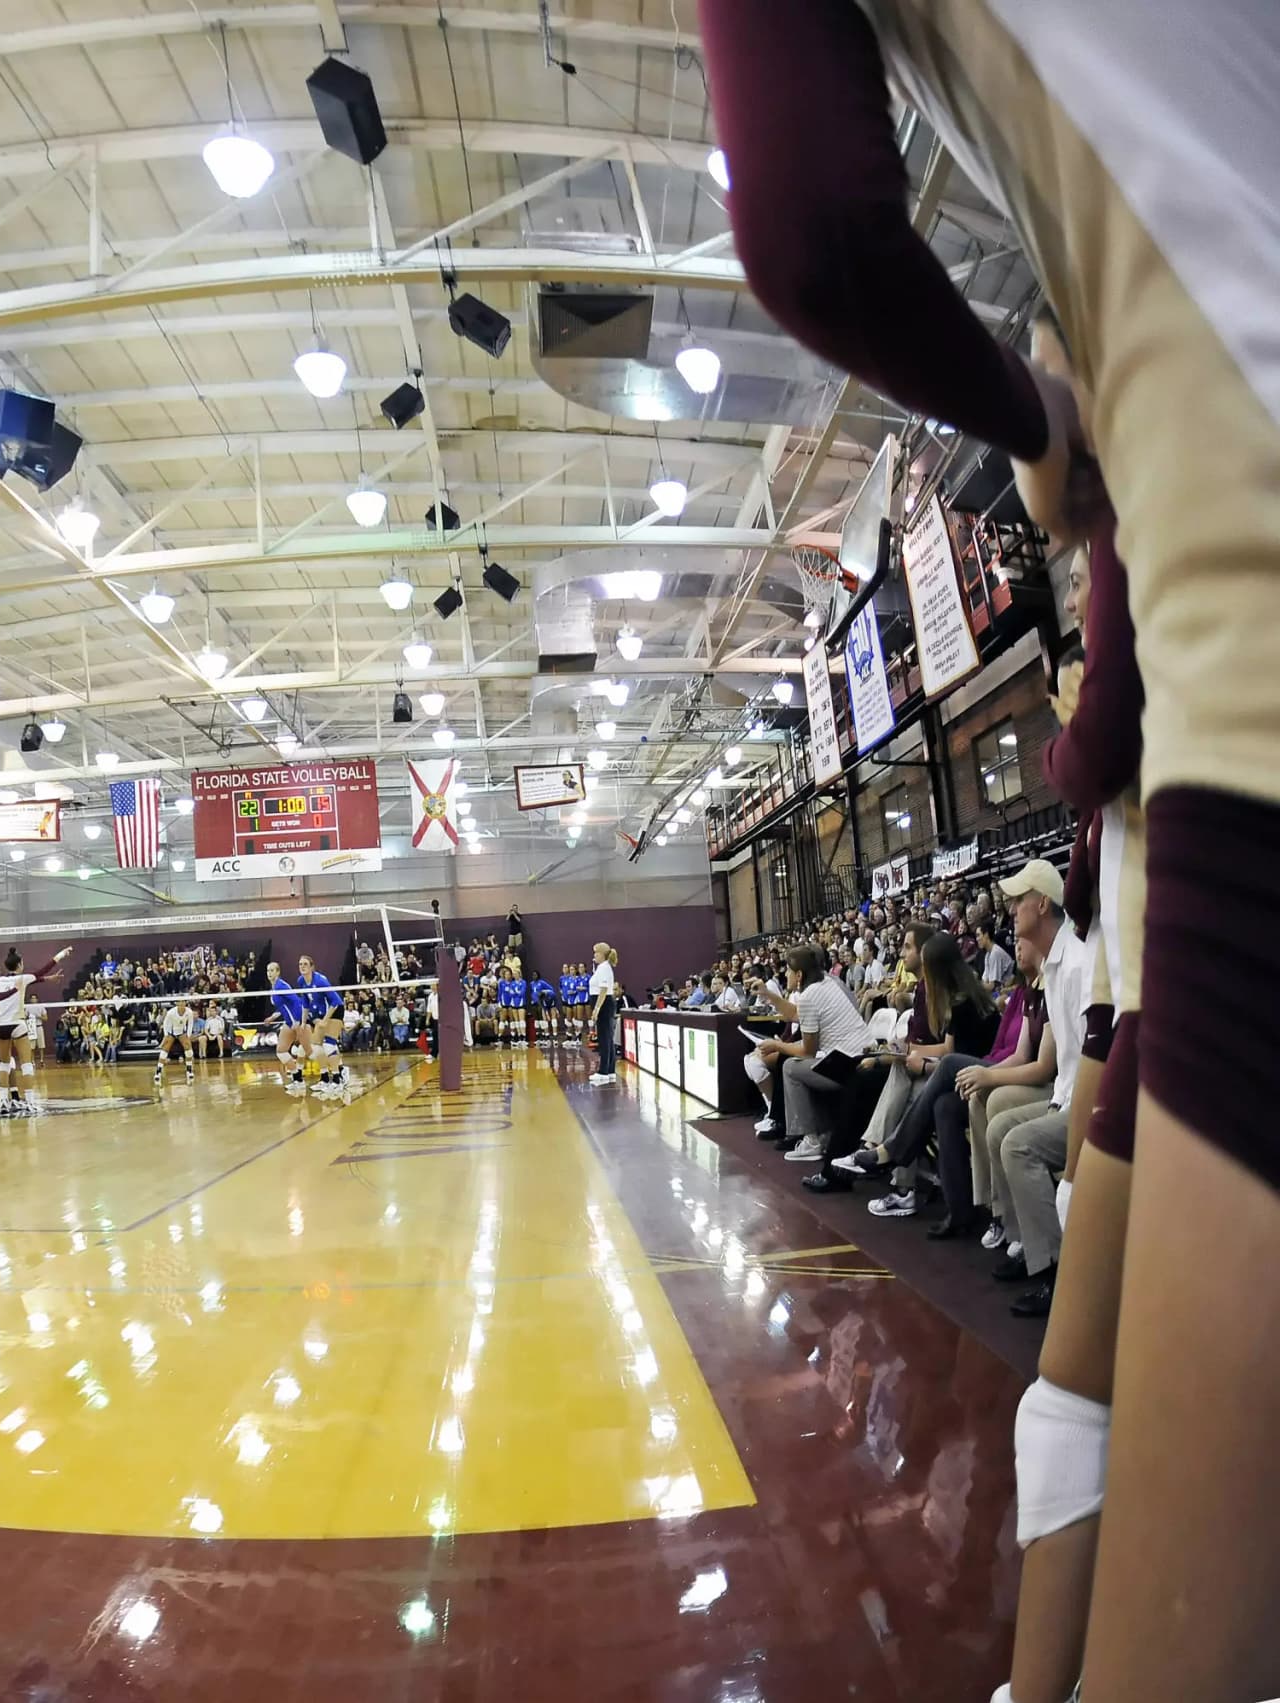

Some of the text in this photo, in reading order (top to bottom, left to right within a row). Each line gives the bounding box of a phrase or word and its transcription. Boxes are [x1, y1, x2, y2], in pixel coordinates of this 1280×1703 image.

[195, 766, 370, 790] FLORIDA STATE VOLLEYBALL
[239, 802, 257, 816] 22
[278, 798, 305, 813] 1:00
[212, 860, 241, 873] ACC
